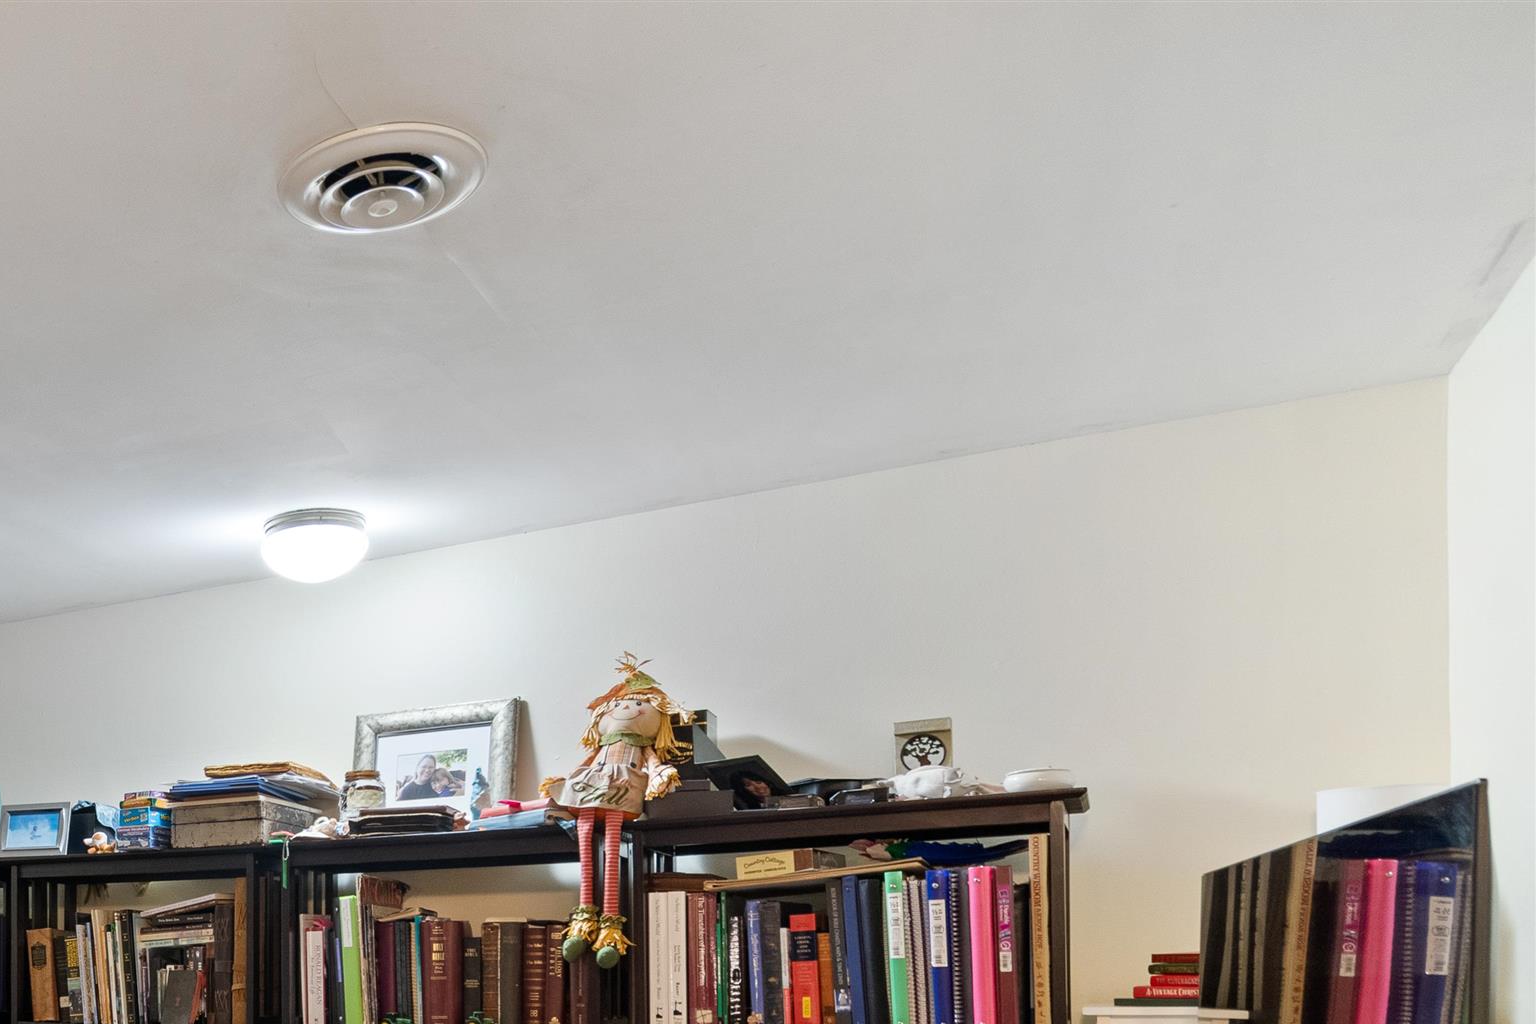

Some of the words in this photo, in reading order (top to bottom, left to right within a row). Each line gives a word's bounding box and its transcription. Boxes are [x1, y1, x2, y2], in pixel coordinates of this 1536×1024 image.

[1032, 836, 1042, 873] COUNTRY
[1033, 874, 1043, 908] WISDOM
[697, 897, 705, 908] The
[831, 899, 839, 911] BOOK
[697, 910, 705, 939] Timetables
[433, 943, 444, 951] HOLY
